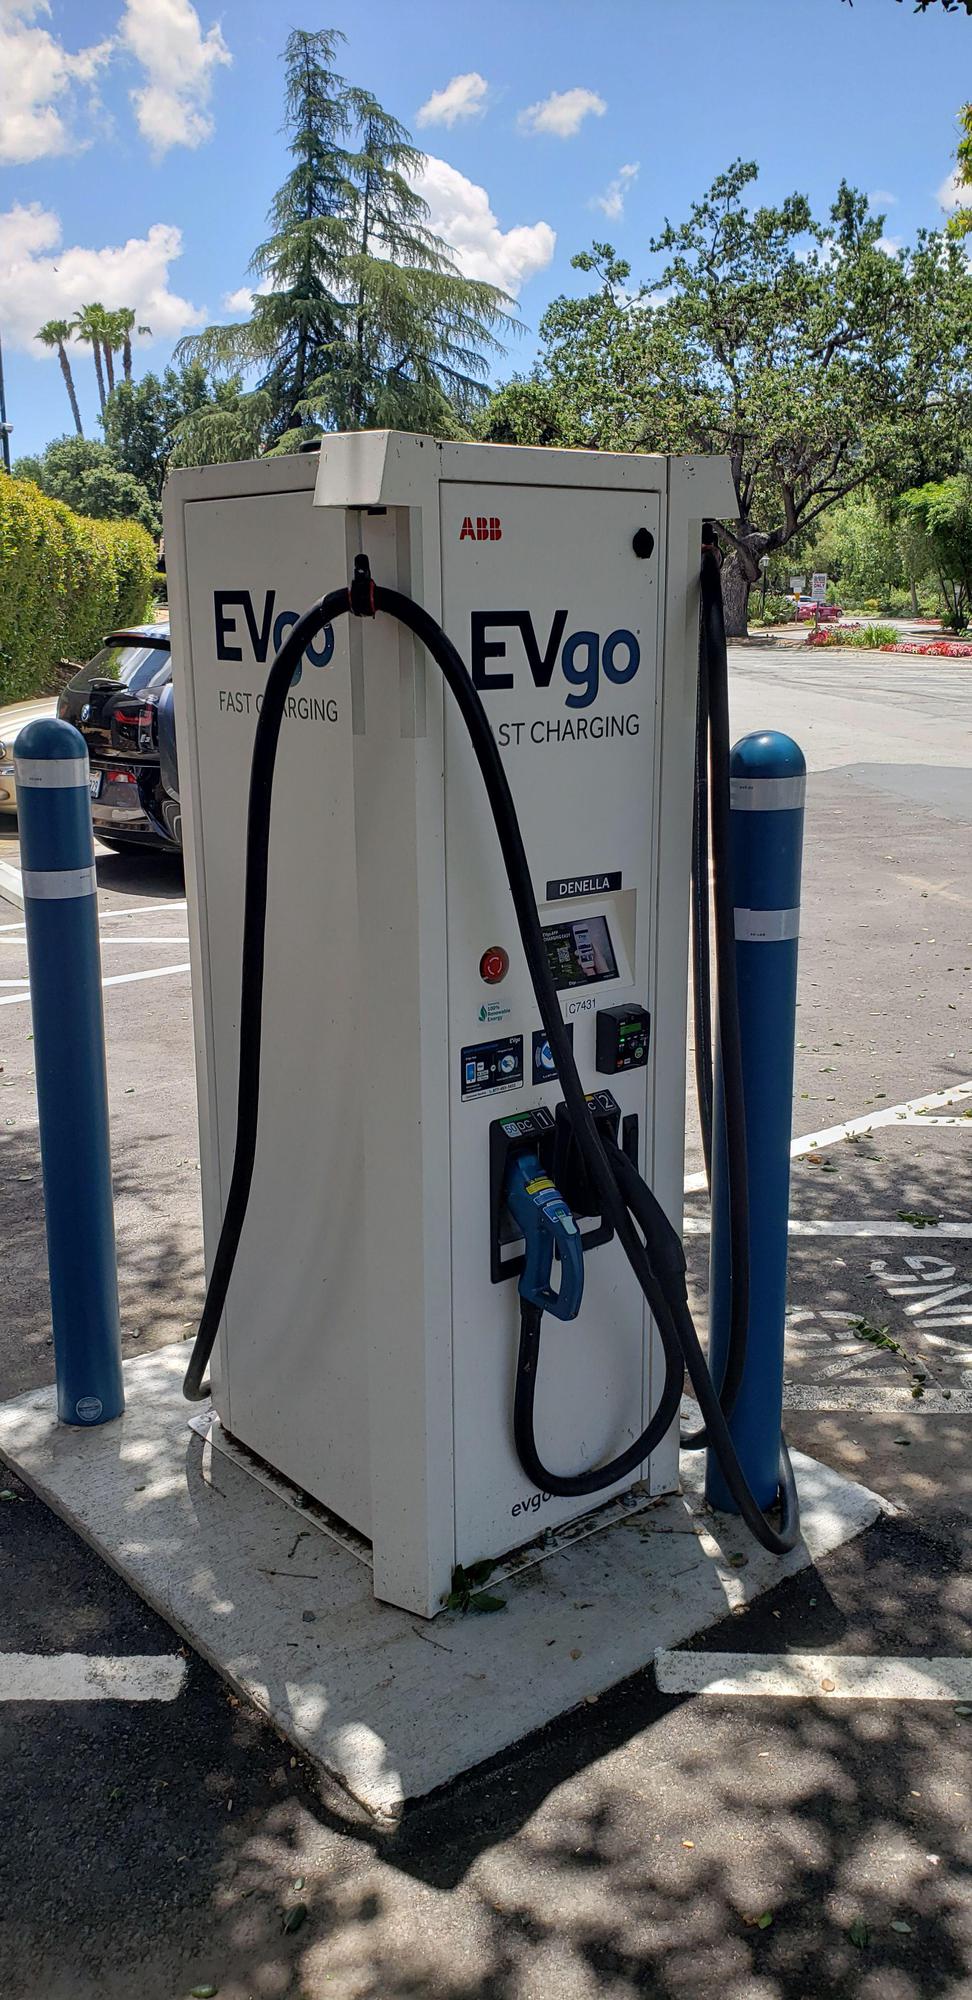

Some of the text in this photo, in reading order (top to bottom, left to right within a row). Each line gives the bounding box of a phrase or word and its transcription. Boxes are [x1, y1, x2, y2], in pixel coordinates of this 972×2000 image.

[459, 517, 502, 540] ABB
[471, 610, 641, 709] EVgo
[219, 690, 338, 722] FAST CRGING
[530, 713, 640, 743] CHARGING
[559, 876, 610, 895] DENELLA
[488, 1008, 511, 1017] Renewable
[569, 998, 597, 1014] C7431
[598, 1094, 614, 1109] 2
[505, 1112, 549, 1133] 50 DC 1
